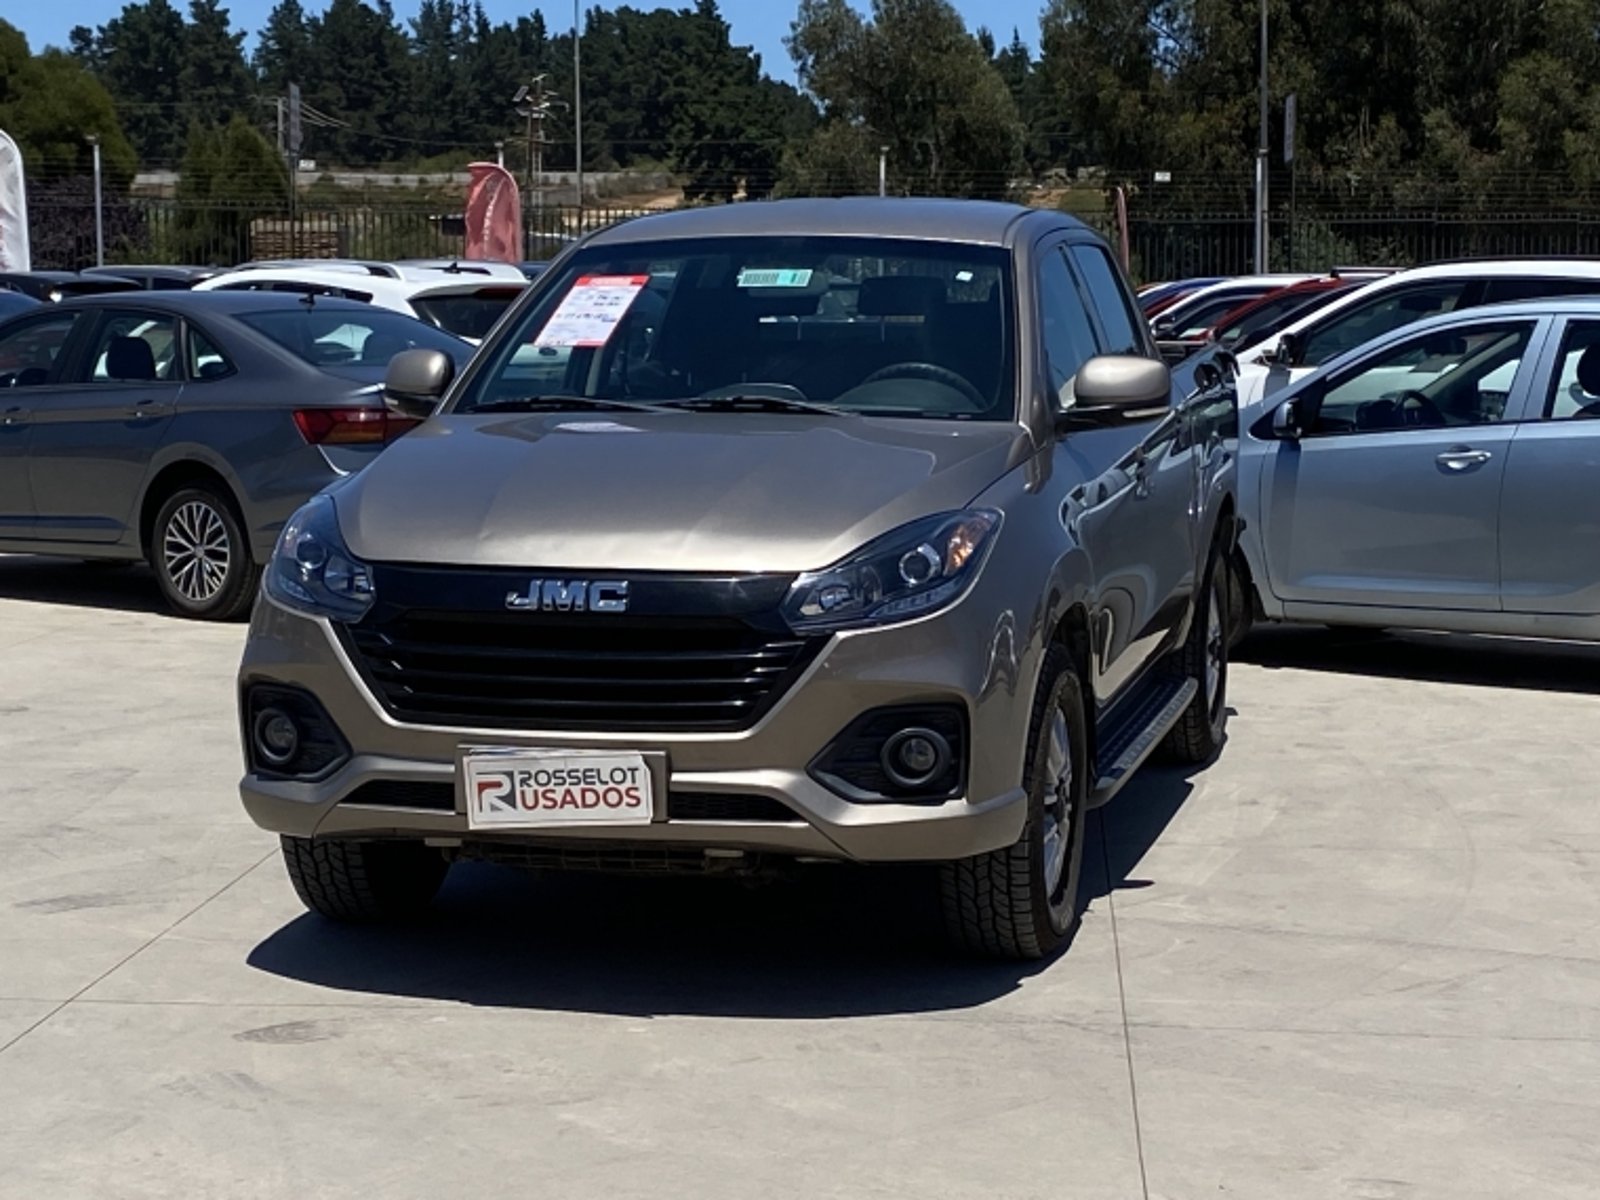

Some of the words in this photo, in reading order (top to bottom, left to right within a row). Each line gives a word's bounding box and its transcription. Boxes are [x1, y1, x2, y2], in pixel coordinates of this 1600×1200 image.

[505, 579, 628, 611] JMC
[519, 767, 639, 788] ROSSELOT
[520, 786, 641, 810] USADOS
